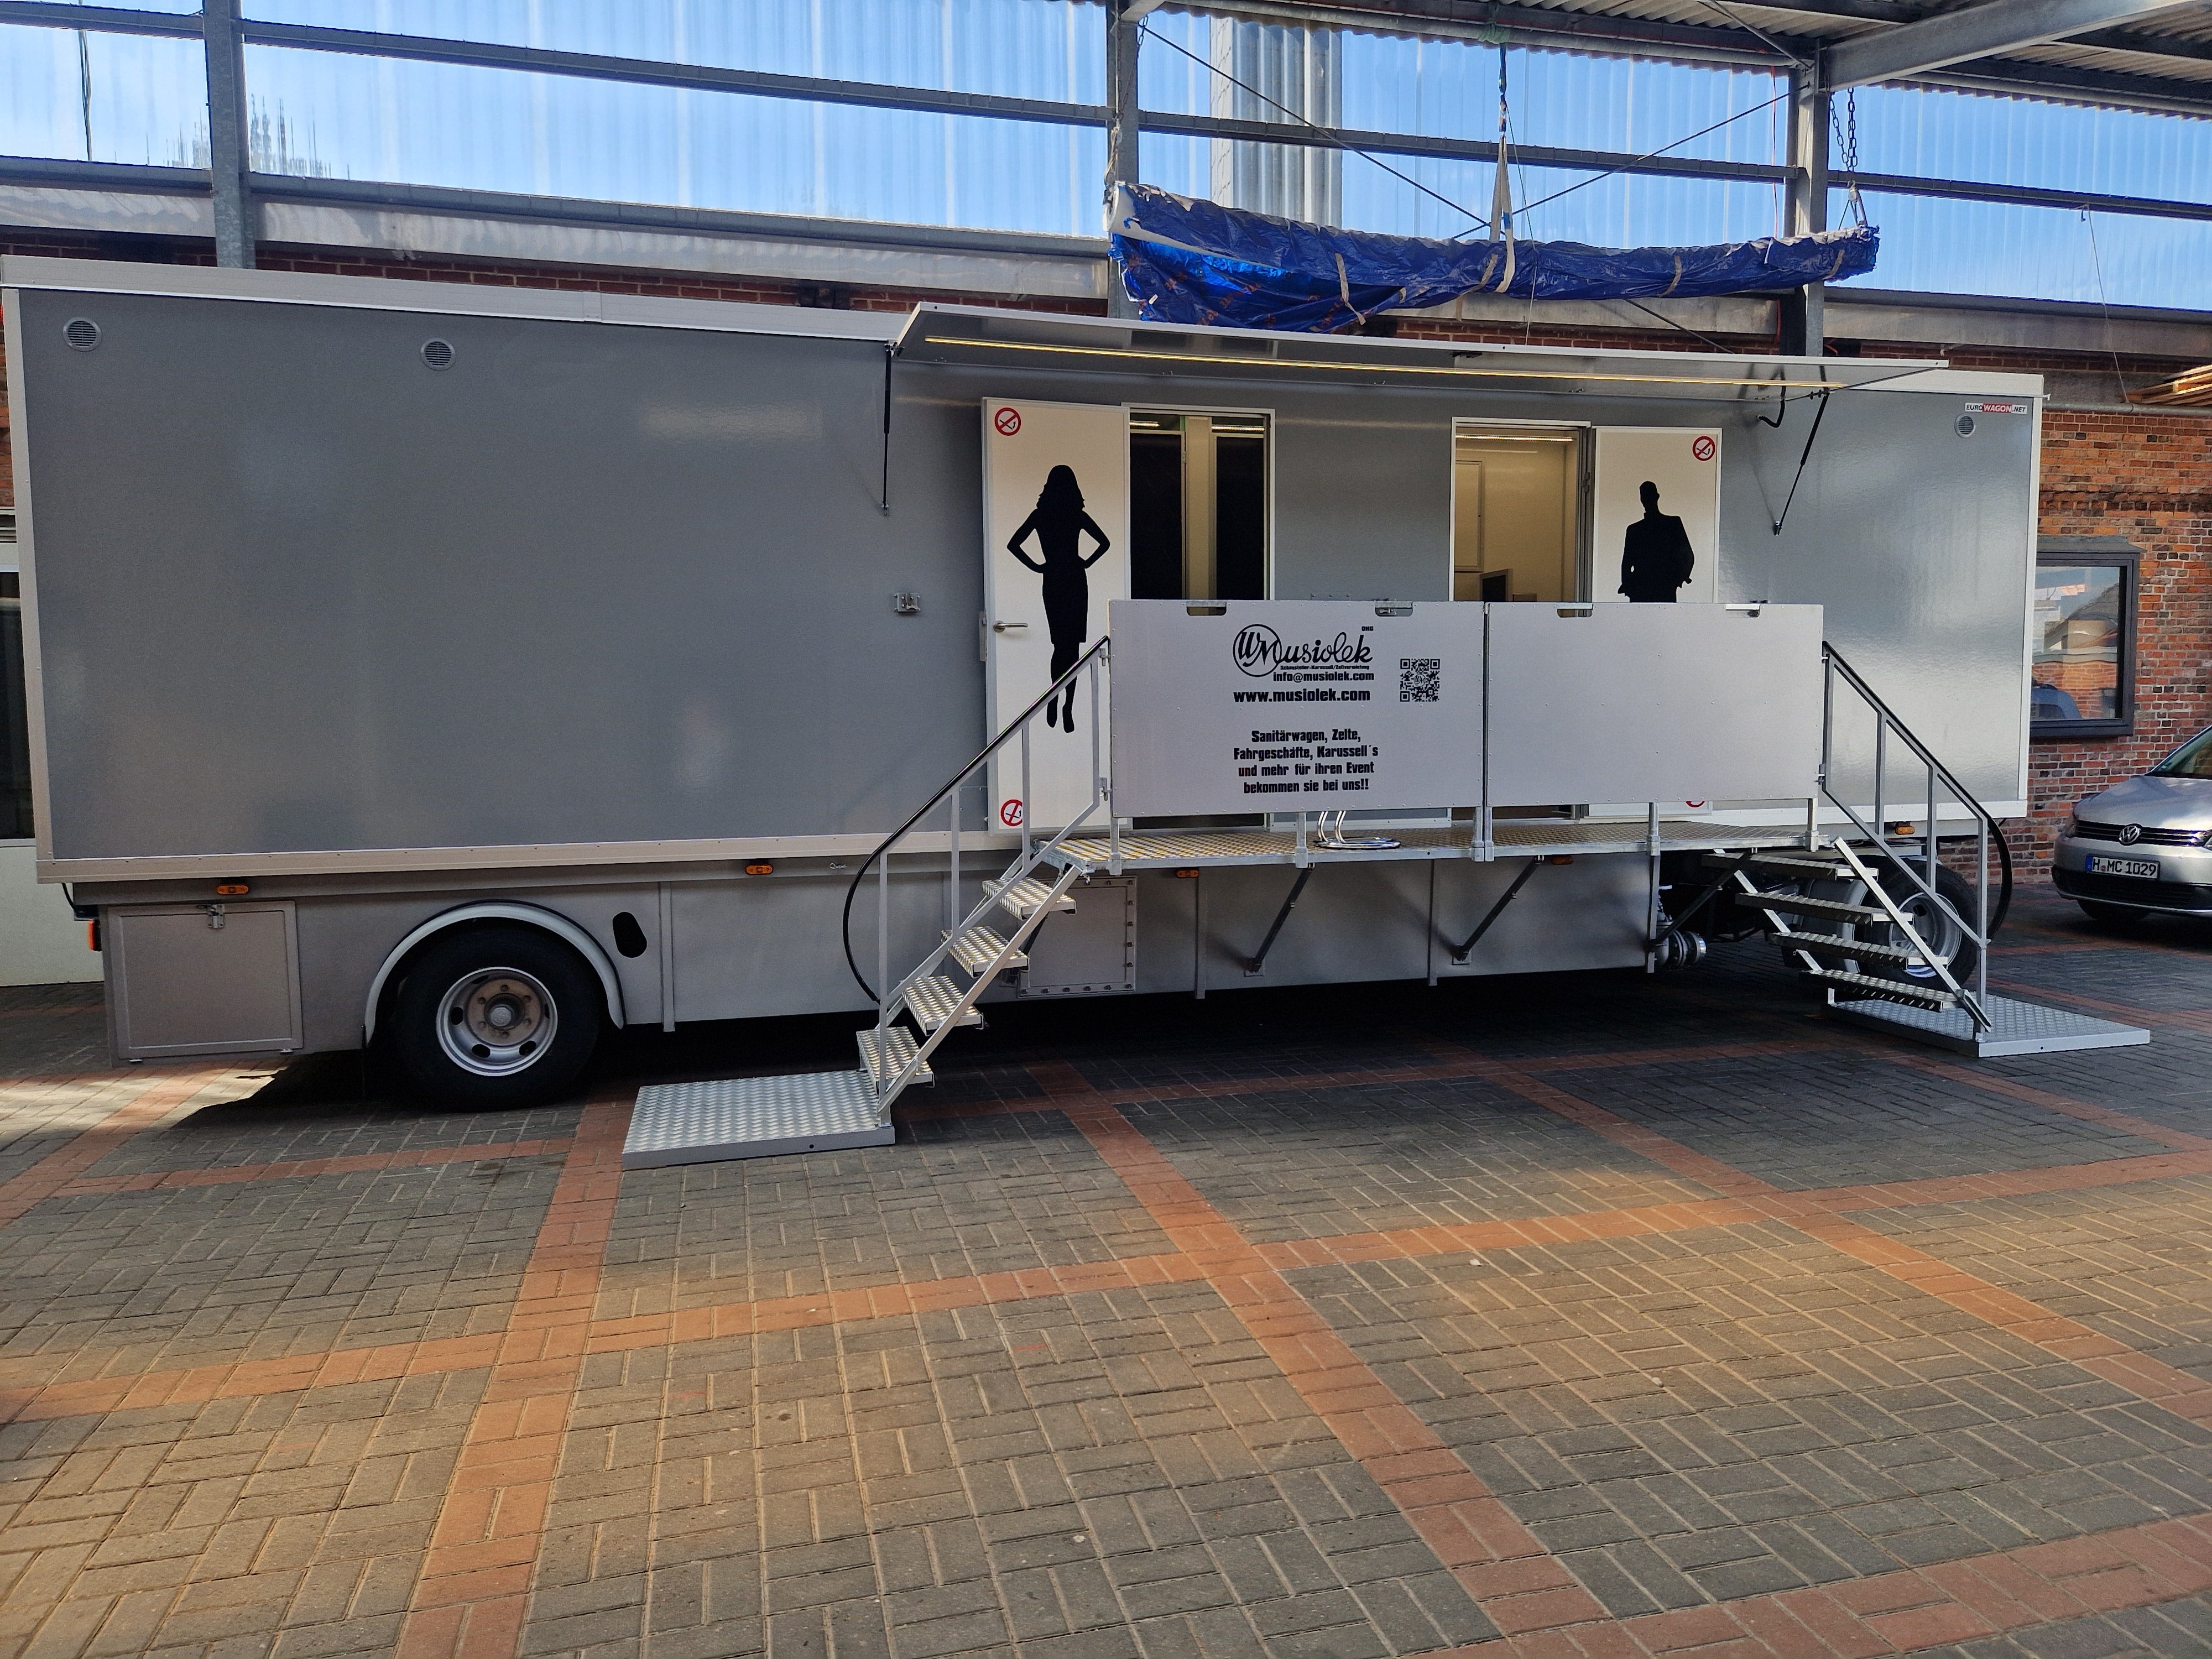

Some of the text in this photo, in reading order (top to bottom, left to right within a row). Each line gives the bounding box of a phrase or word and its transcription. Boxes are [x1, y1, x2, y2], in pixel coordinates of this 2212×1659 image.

[1966, 404, 2026, 413] EUROWAGON.NET
[1273, 671, 1374, 683] info@musiolek.com
[1233, 688, 1370, 702] www.musiolek.com
[1251, 728, 1361, 743] Sanitärwagen, Zelte,
[1234, 747, 1313, 761] Fahrgeschäfte,
[1238, 761, 1375, 776] und mehr für ihren Event
[1244, 778, 1369, 794] bekommen sie bei uns!!
[2125, 862, 2157, 877] 1029
